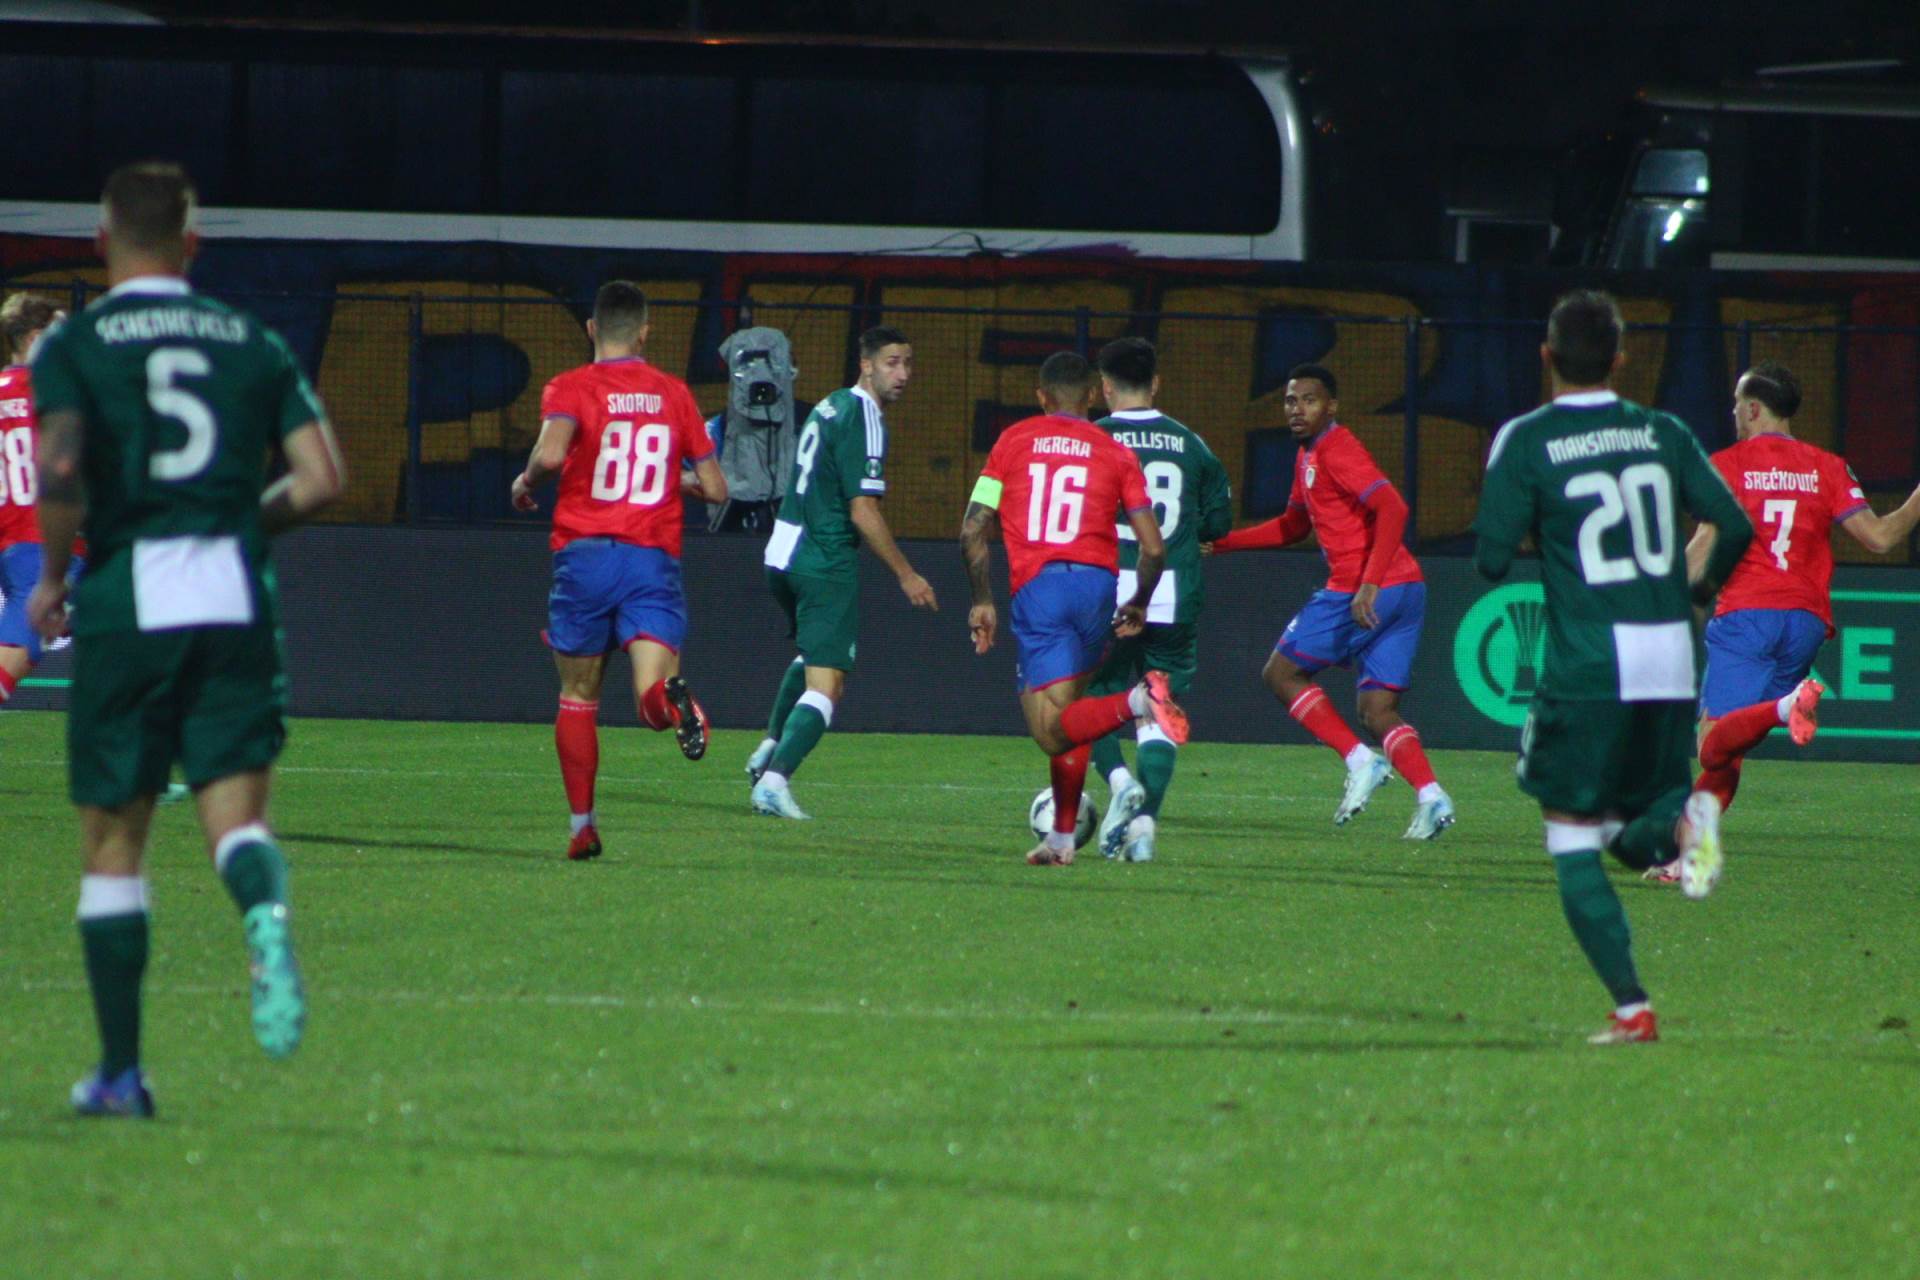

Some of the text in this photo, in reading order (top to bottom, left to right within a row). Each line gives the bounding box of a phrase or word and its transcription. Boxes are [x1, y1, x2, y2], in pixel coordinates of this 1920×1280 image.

[146, 348, 217, 480] 5
[607, 393, 662, 414] SKORUP
[591, 421, 670, 505] 88
[1033, 436, 1091, 458] HERERA
[1113, 432, 1184, 453] PELLISTRI
[1546, 424, 1660, 465] MAKSIMOVIĆ
[1027, 463, 1088, 543] 16
[1115, 461, 1183, 541] 8
[1564, 463, 1674, 585] 20
[1763, 499, 1797, 571] 7
